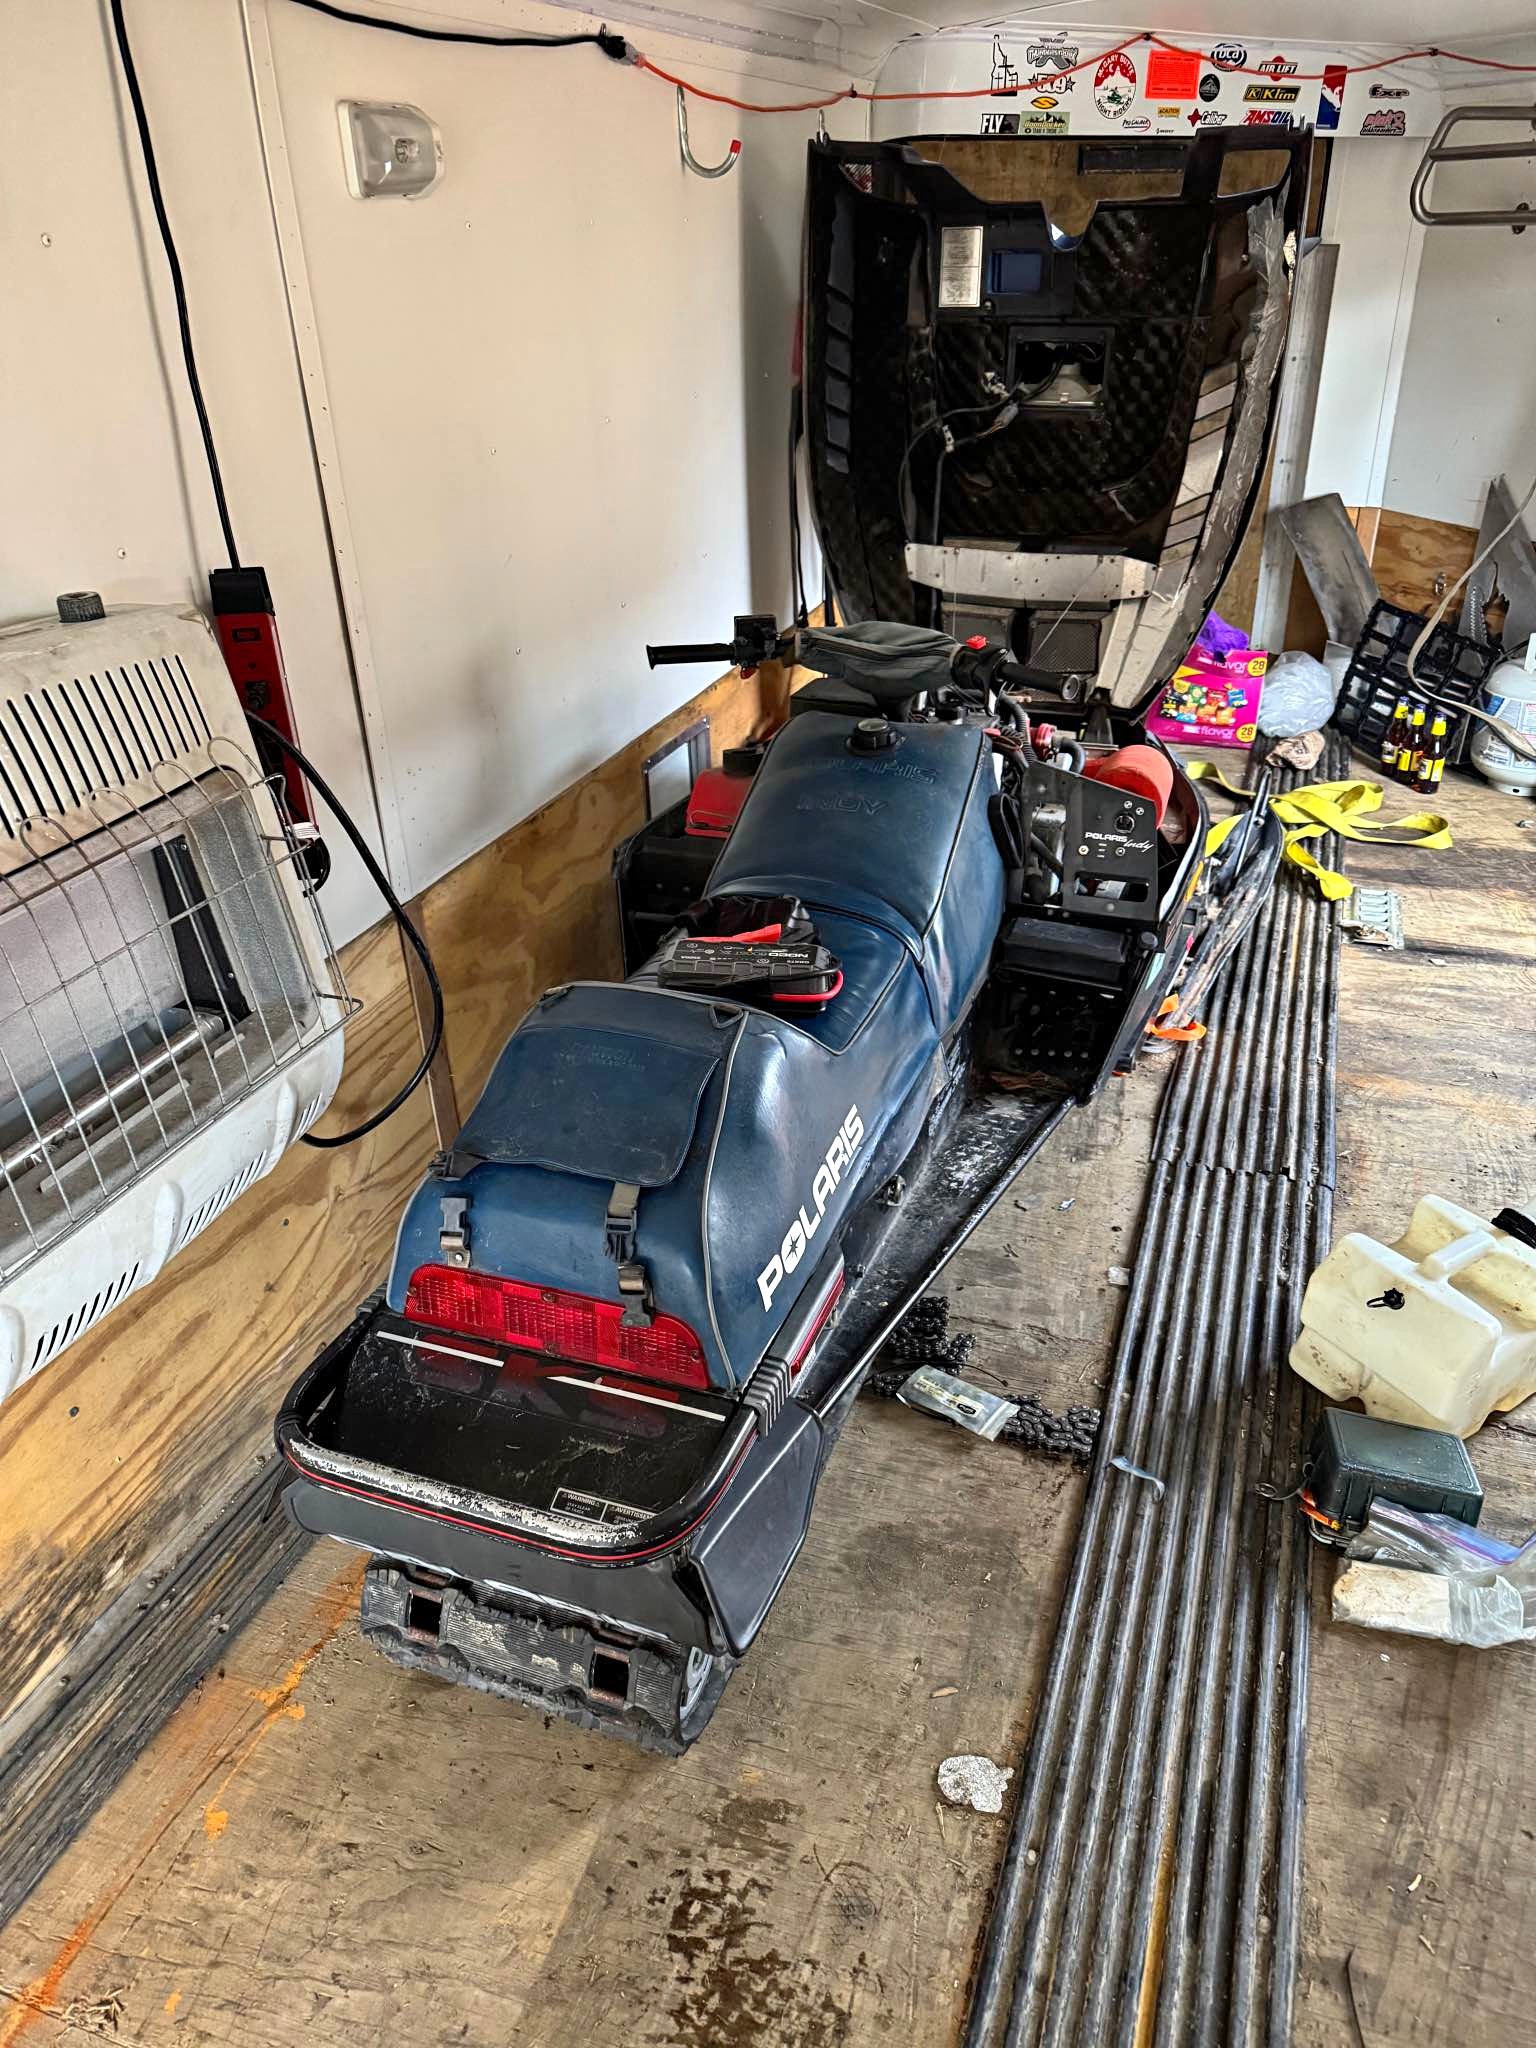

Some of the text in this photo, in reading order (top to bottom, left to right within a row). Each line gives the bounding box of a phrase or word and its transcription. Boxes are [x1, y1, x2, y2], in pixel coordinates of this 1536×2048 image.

[1259, 63, 1297, 74] AIR LIFT
[1096, 96, 1133, 117] NIGHT RIDERS
[1243, 110, 1292, 125] AMSOIL
[981, 114, 1004, 134] FLY
[1252, 660, 1266, 671] 28
[1201, 725, 1236, 737] flavor
[1241, 726, 1254, 736] 28
[1085, 832, 1128, 843] POLARIS
[757, 1104, 864, 1312] POLARIS
[567, 1493, 596, 1506] WARNING
